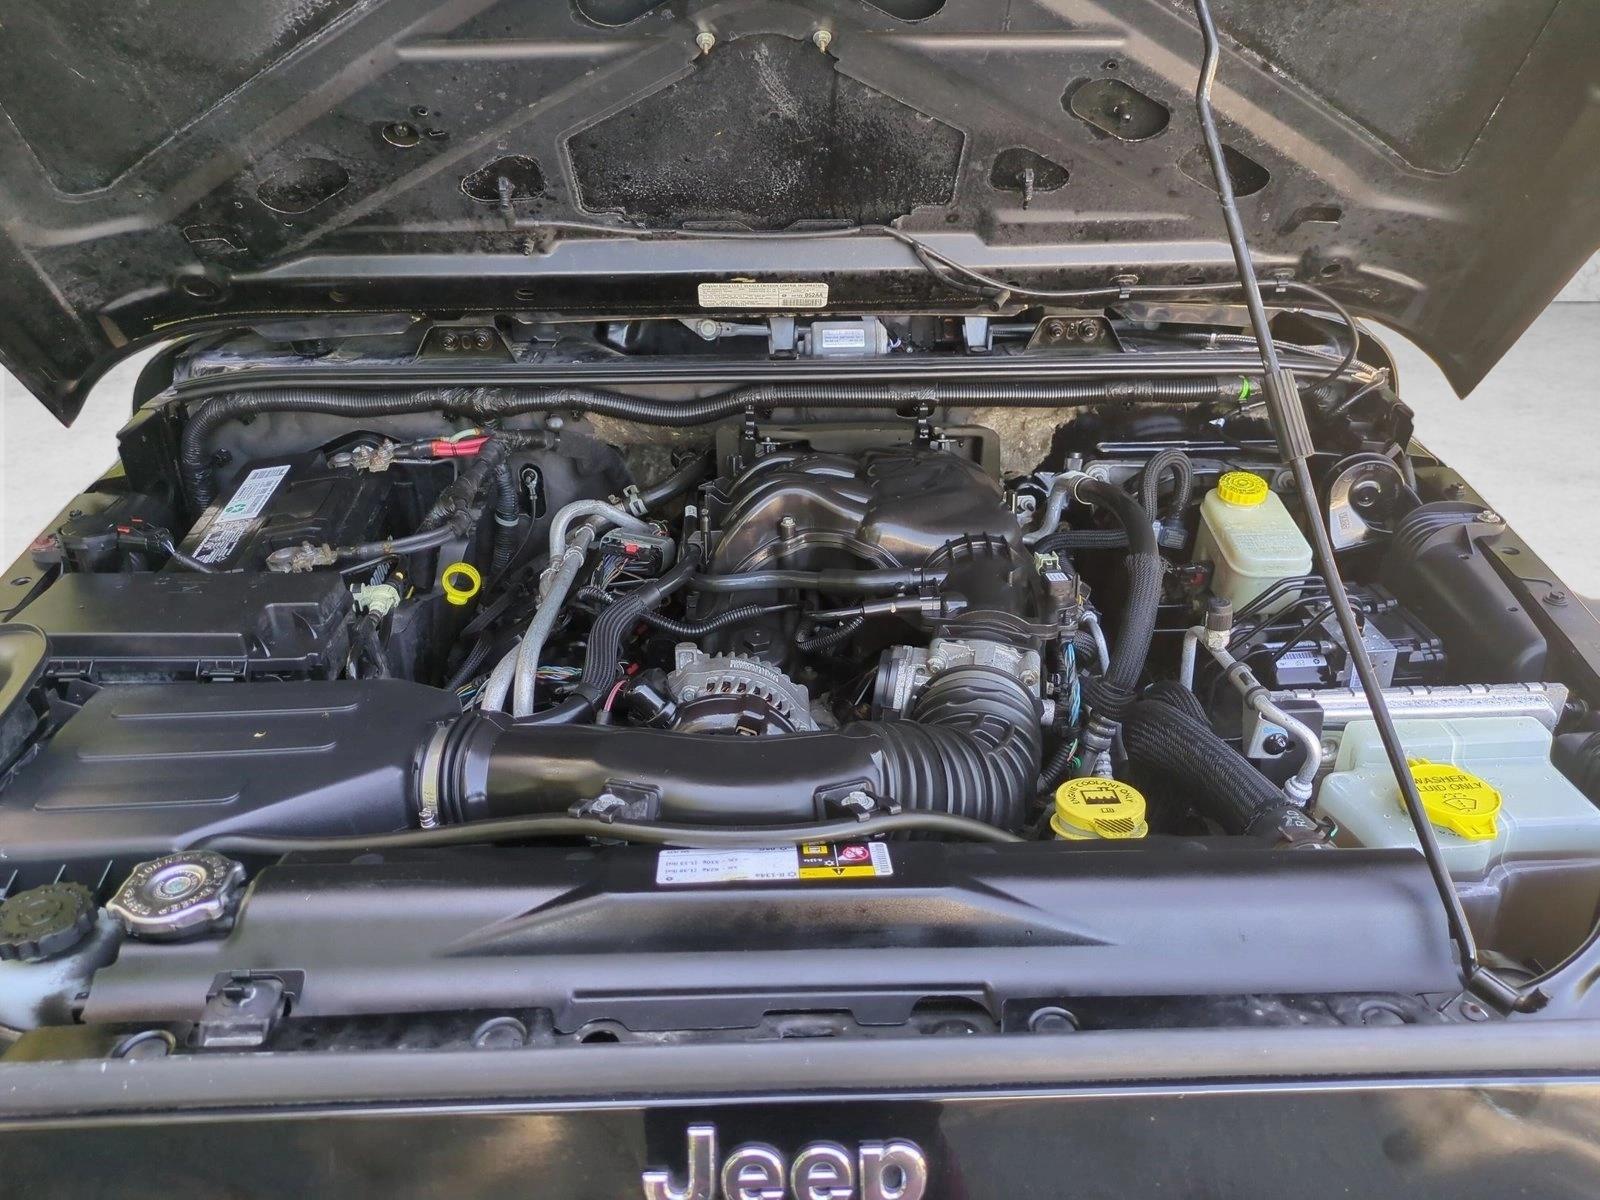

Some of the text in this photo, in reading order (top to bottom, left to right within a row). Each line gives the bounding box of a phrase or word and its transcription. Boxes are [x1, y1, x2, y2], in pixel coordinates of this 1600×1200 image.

[1414, 774, 1469, 785] WASHER
[1415, 782, 1482, 792] LUID ONLY
[1076, 780, 1119, 790] COOLANT
[1119, 788, 1135, 804] ONLY
[642, 1123, 926, 1200] Jeep
